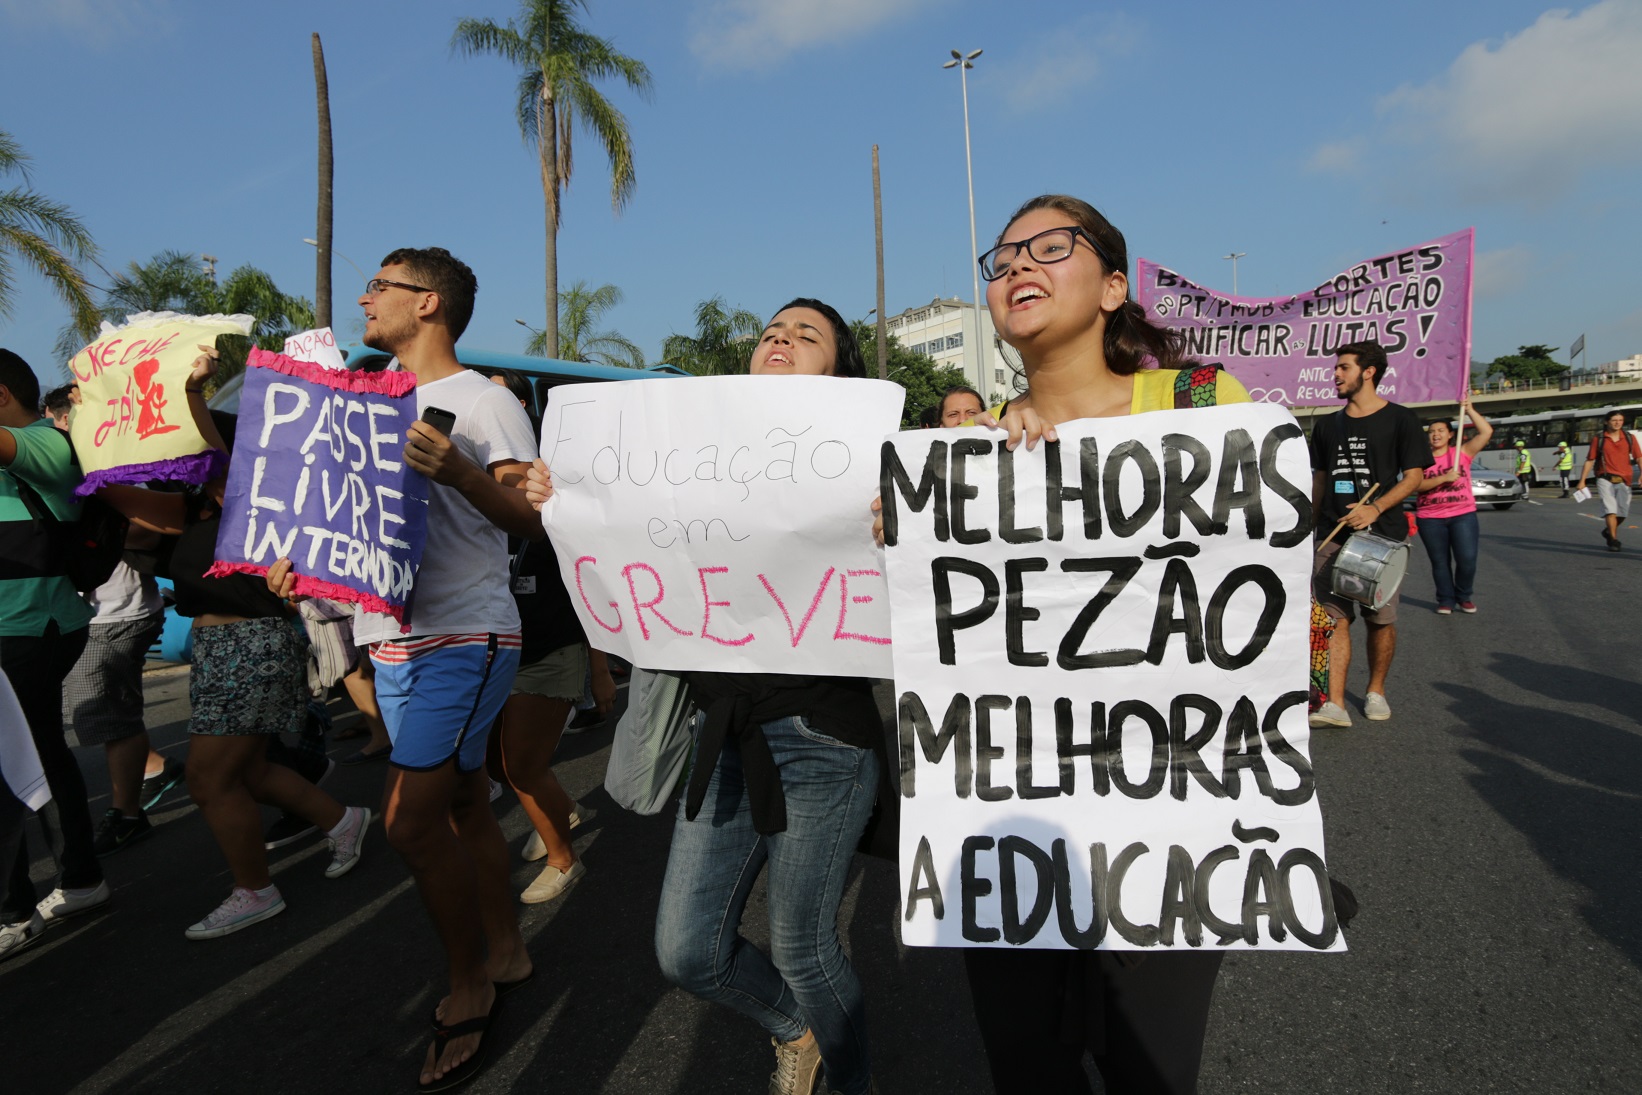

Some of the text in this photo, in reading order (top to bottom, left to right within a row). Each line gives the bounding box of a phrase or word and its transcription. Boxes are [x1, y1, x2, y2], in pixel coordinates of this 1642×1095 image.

[1155, 295, 1175, 317] DO
[1303, 275, 1442, 318] EDUCAÇÃO
[1313, 246, 1443, 298] CORTES
[1306, 312, 1438, 358] LUTAS!
[259, 382, 402, 473] PASSE
[549, 400, 851, 502] Educação
[251, 453, 411, 549] LIVRE
[880, 422, 1314, 548] MELHORAS
[244, 508, 418, 601] INTERMODA
[648, 517, 750, 548] em
[574, 556, 892, 647] GREVE
[932, 541, 1286, 671] PEZÃO
[899, 690, 1316, 806] MELHORAS
[905, 818, 1338, 950] A EDUCAÇÃO
